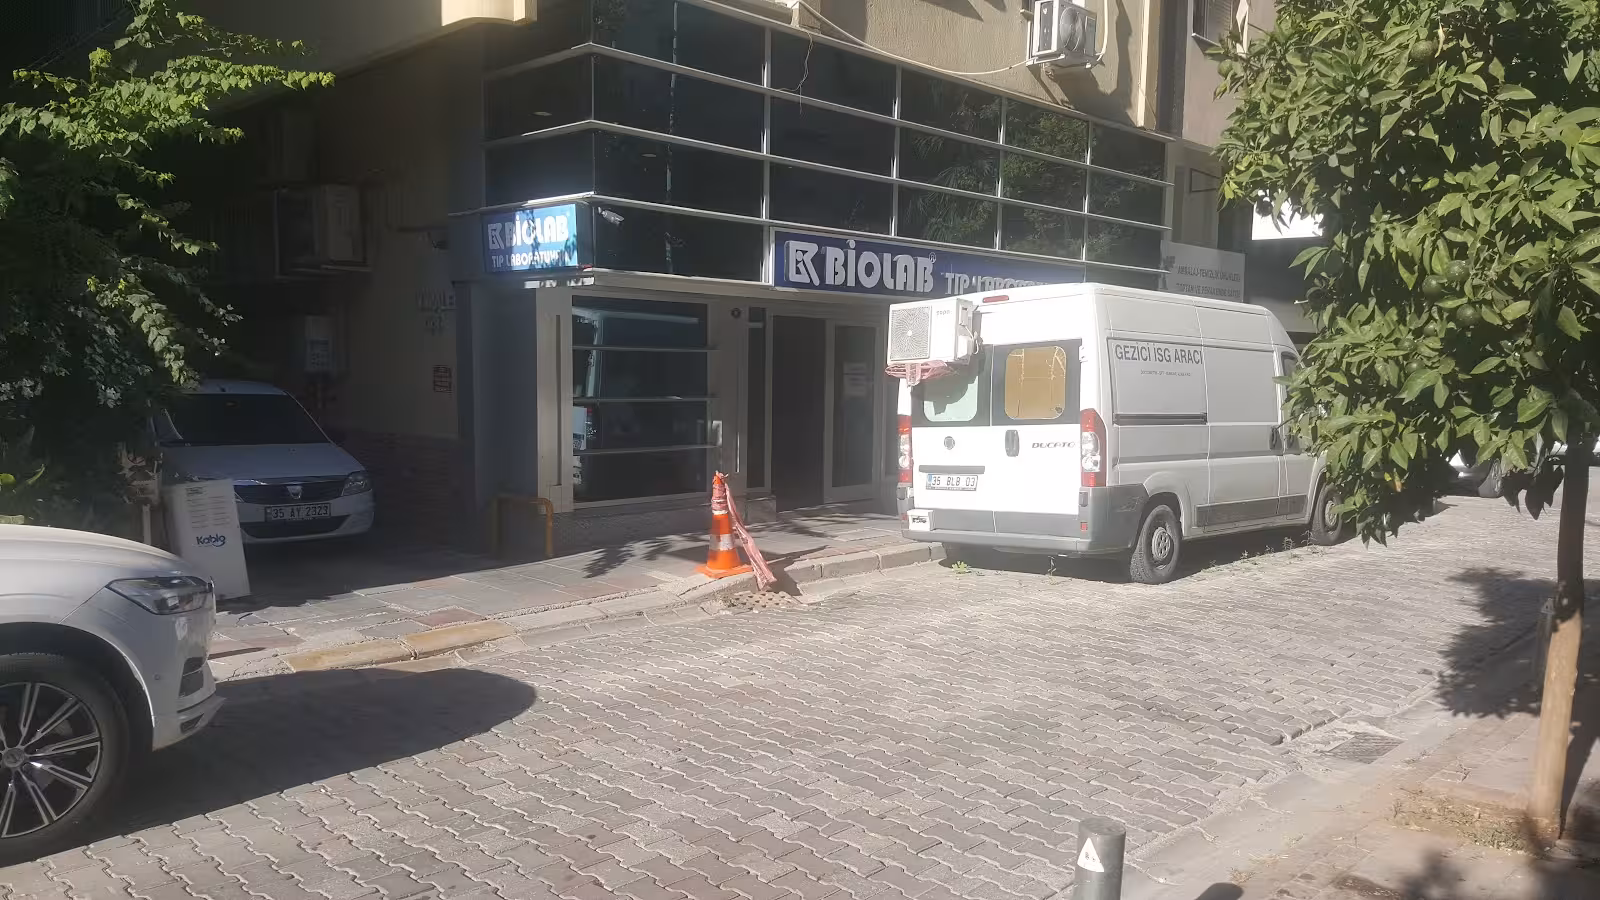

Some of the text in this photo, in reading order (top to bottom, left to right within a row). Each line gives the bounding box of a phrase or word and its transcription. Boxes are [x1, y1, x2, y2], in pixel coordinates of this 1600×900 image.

[944, 272, 969, 294] TIP
[1115, 342, 1151, 361] GEZİCİ
[1153, 343, 1171, 363] İSG
[1031, 441, 1076, 449] DUCATO
[932, 476, 975, 487] 35 BLB 03
[272, 508, 285, 518] 35
[305, 505, 328, 516] 2323
